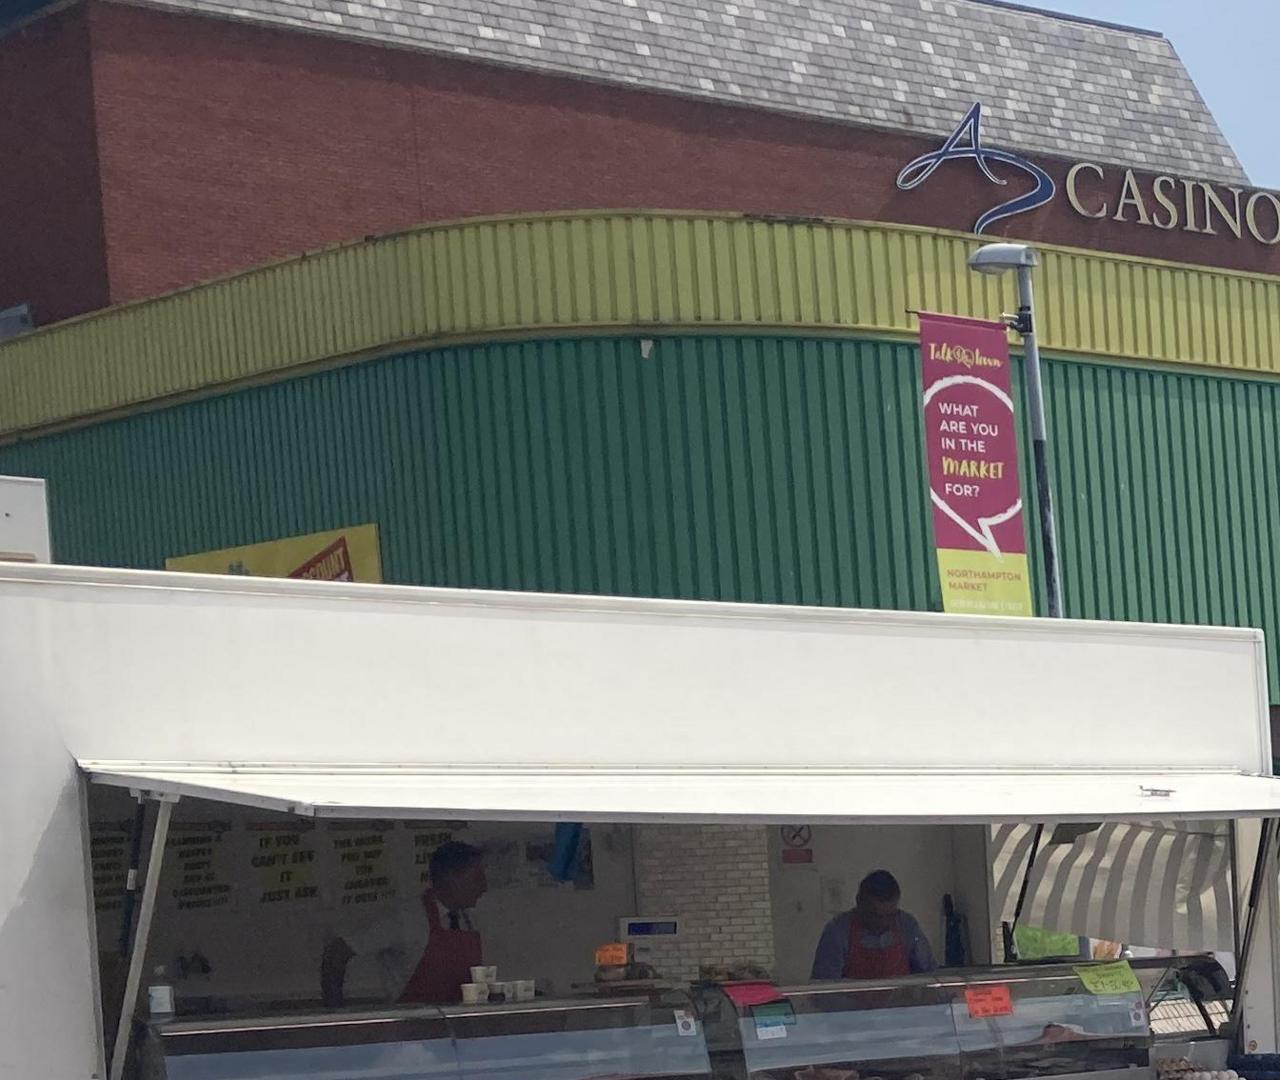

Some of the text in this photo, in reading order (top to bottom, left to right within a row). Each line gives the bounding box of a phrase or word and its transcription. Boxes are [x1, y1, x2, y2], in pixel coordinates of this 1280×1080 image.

[938, 402, 979, 417] WHAT
[940, 420, 999, 437] ARE YOU
[941, 437, 986, 453] IN THE
[941, 456, 1004, 479] MARKET
[945, 483, 980, 497] FOR?
[946, 568, 1023, 582] NORTHAMPTON
[948, 581, 988, 593] MARKET
